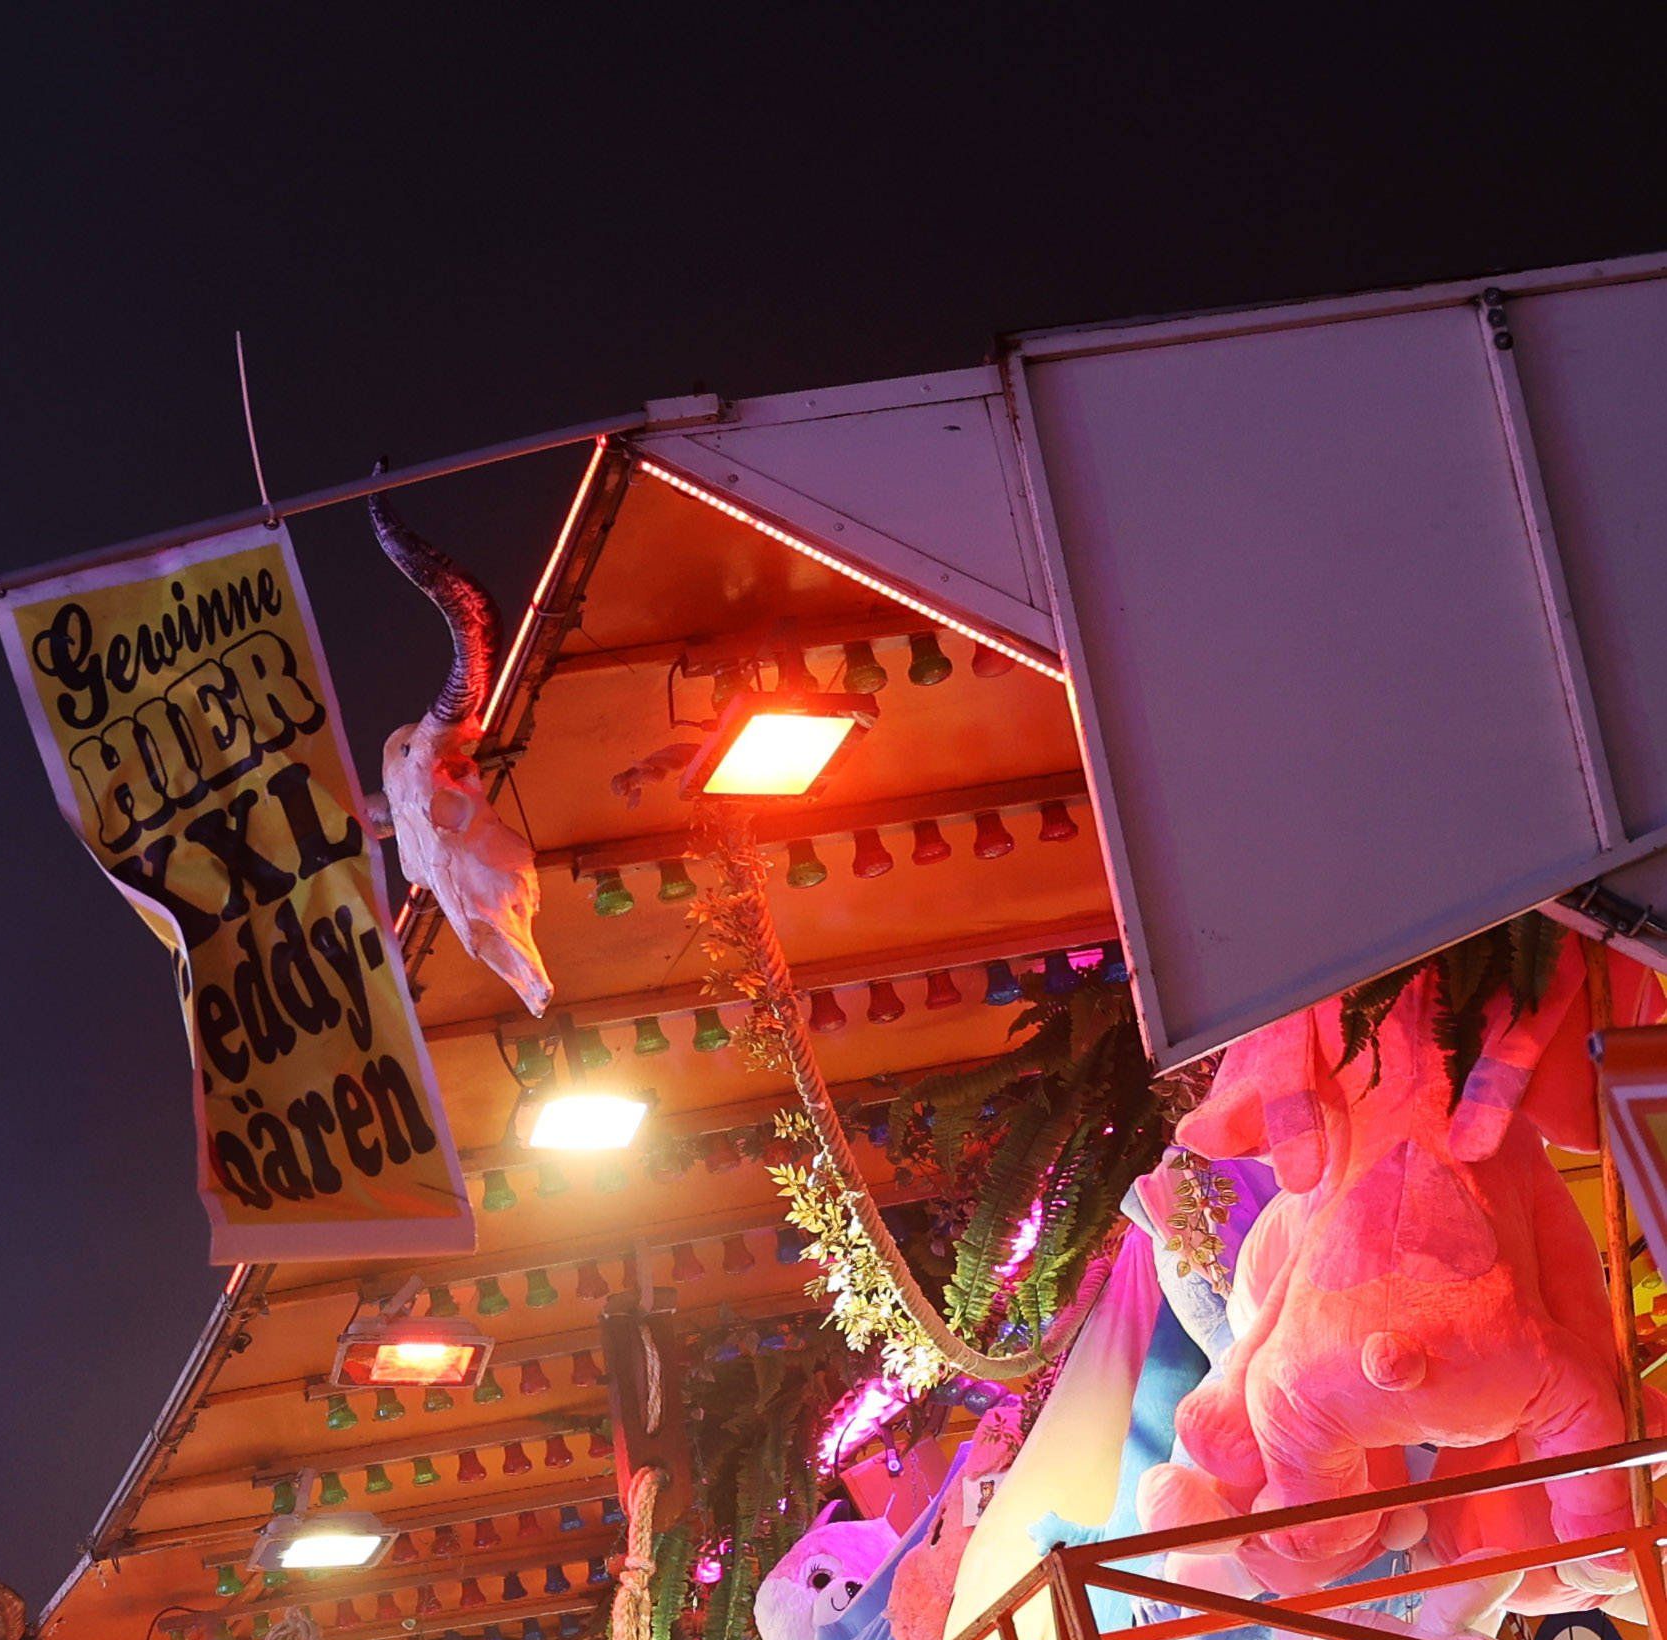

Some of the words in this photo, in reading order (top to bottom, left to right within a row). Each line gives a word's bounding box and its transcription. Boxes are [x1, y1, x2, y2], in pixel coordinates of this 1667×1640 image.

[32, 566, 283, 730] Gewinne
[70, 629, 326, 854] HIER
[110, 762, 363, 948] XXL
[200, 900, 386, 1095] eddy-
